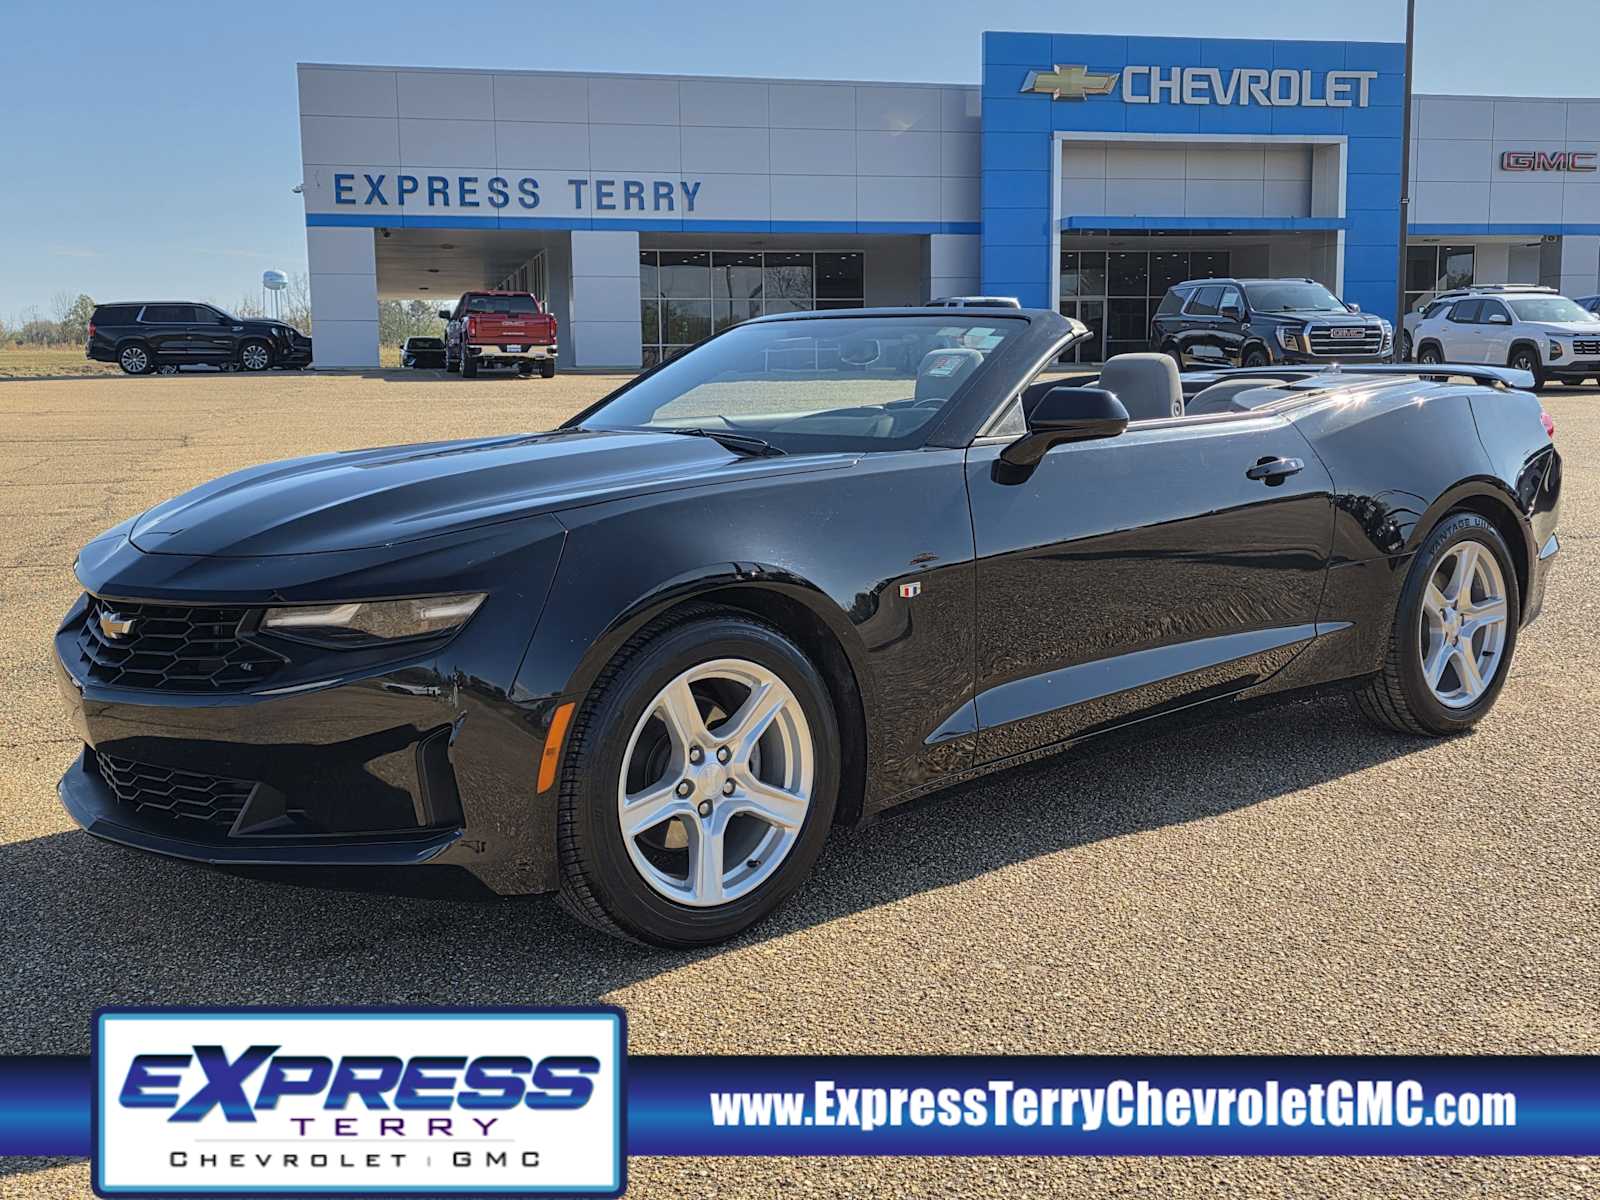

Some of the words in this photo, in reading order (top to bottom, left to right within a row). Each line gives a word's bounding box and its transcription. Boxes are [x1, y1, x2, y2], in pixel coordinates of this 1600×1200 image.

[1122, 65, 1378, 107] CHEVROLET
[1500, 151, 1598, 172] GMC
[334, 173, 540, 209] EXPRESS
[567, 179, 702, 212] TERRY
